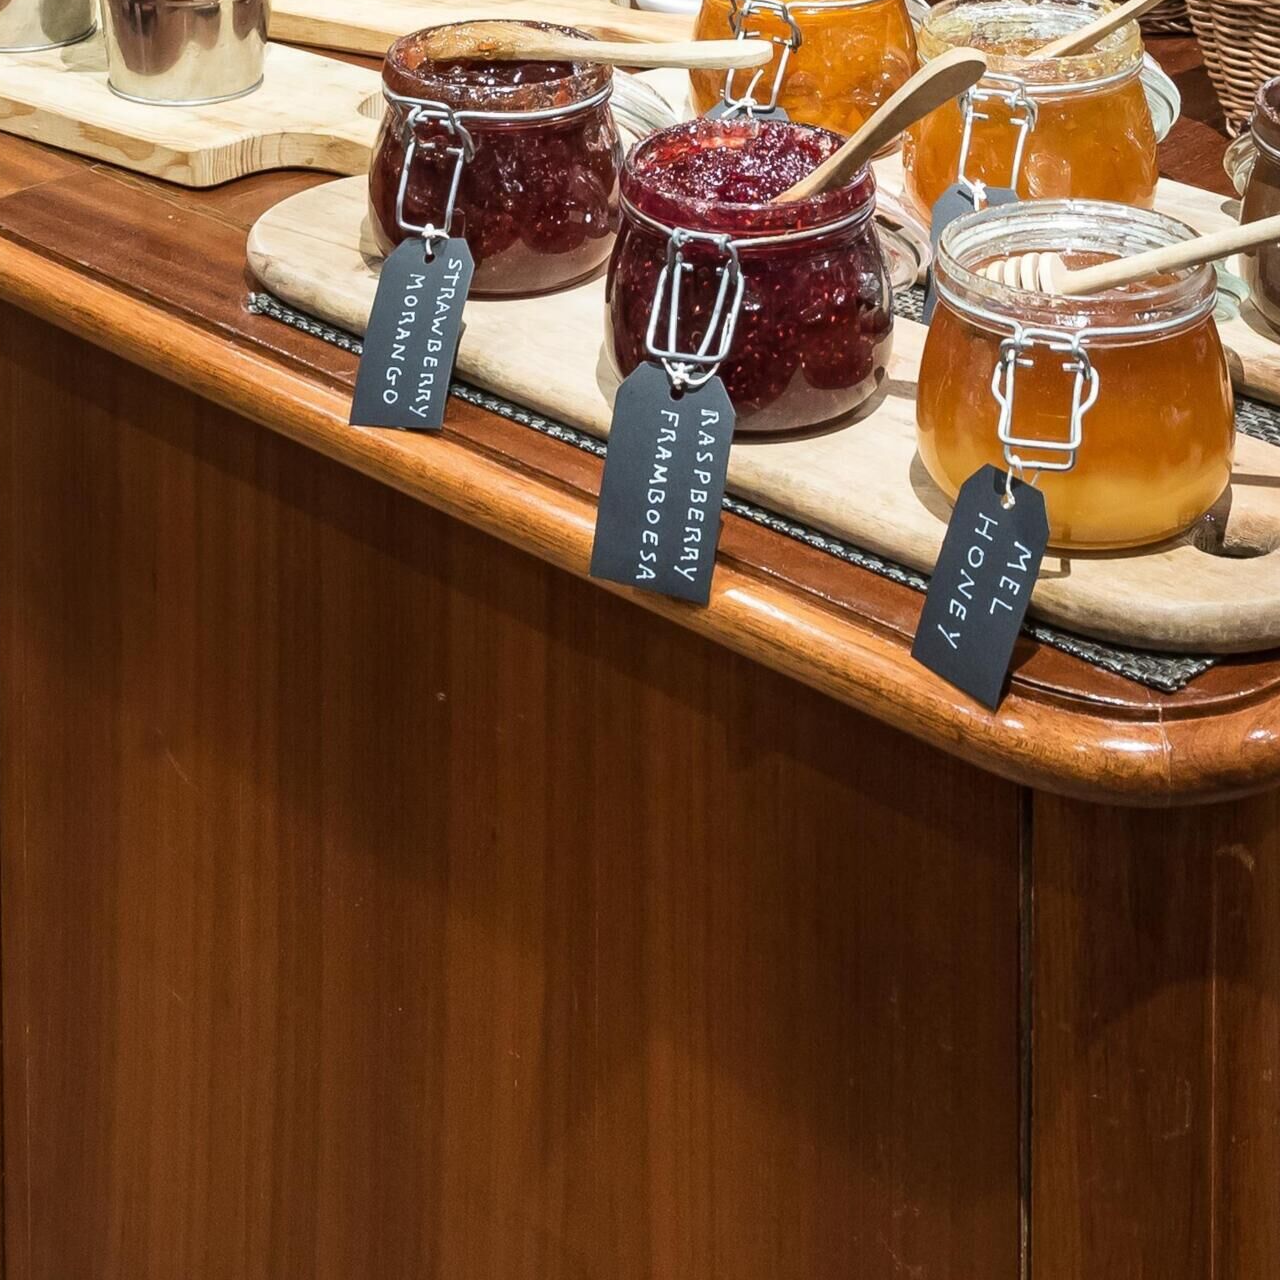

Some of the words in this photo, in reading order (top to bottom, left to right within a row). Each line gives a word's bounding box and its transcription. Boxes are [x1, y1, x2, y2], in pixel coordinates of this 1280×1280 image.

[383, 273, 426, 404] MORANGO
[409, 258, 463, 418] STRAWBERRY
[635, 409, 680, 580] FRAMBOESA
[673, 408, 720, 582] RASPBERRY
[937, 512, 998, 650] HONEY
[989, 541, 1032, 615] MEL
